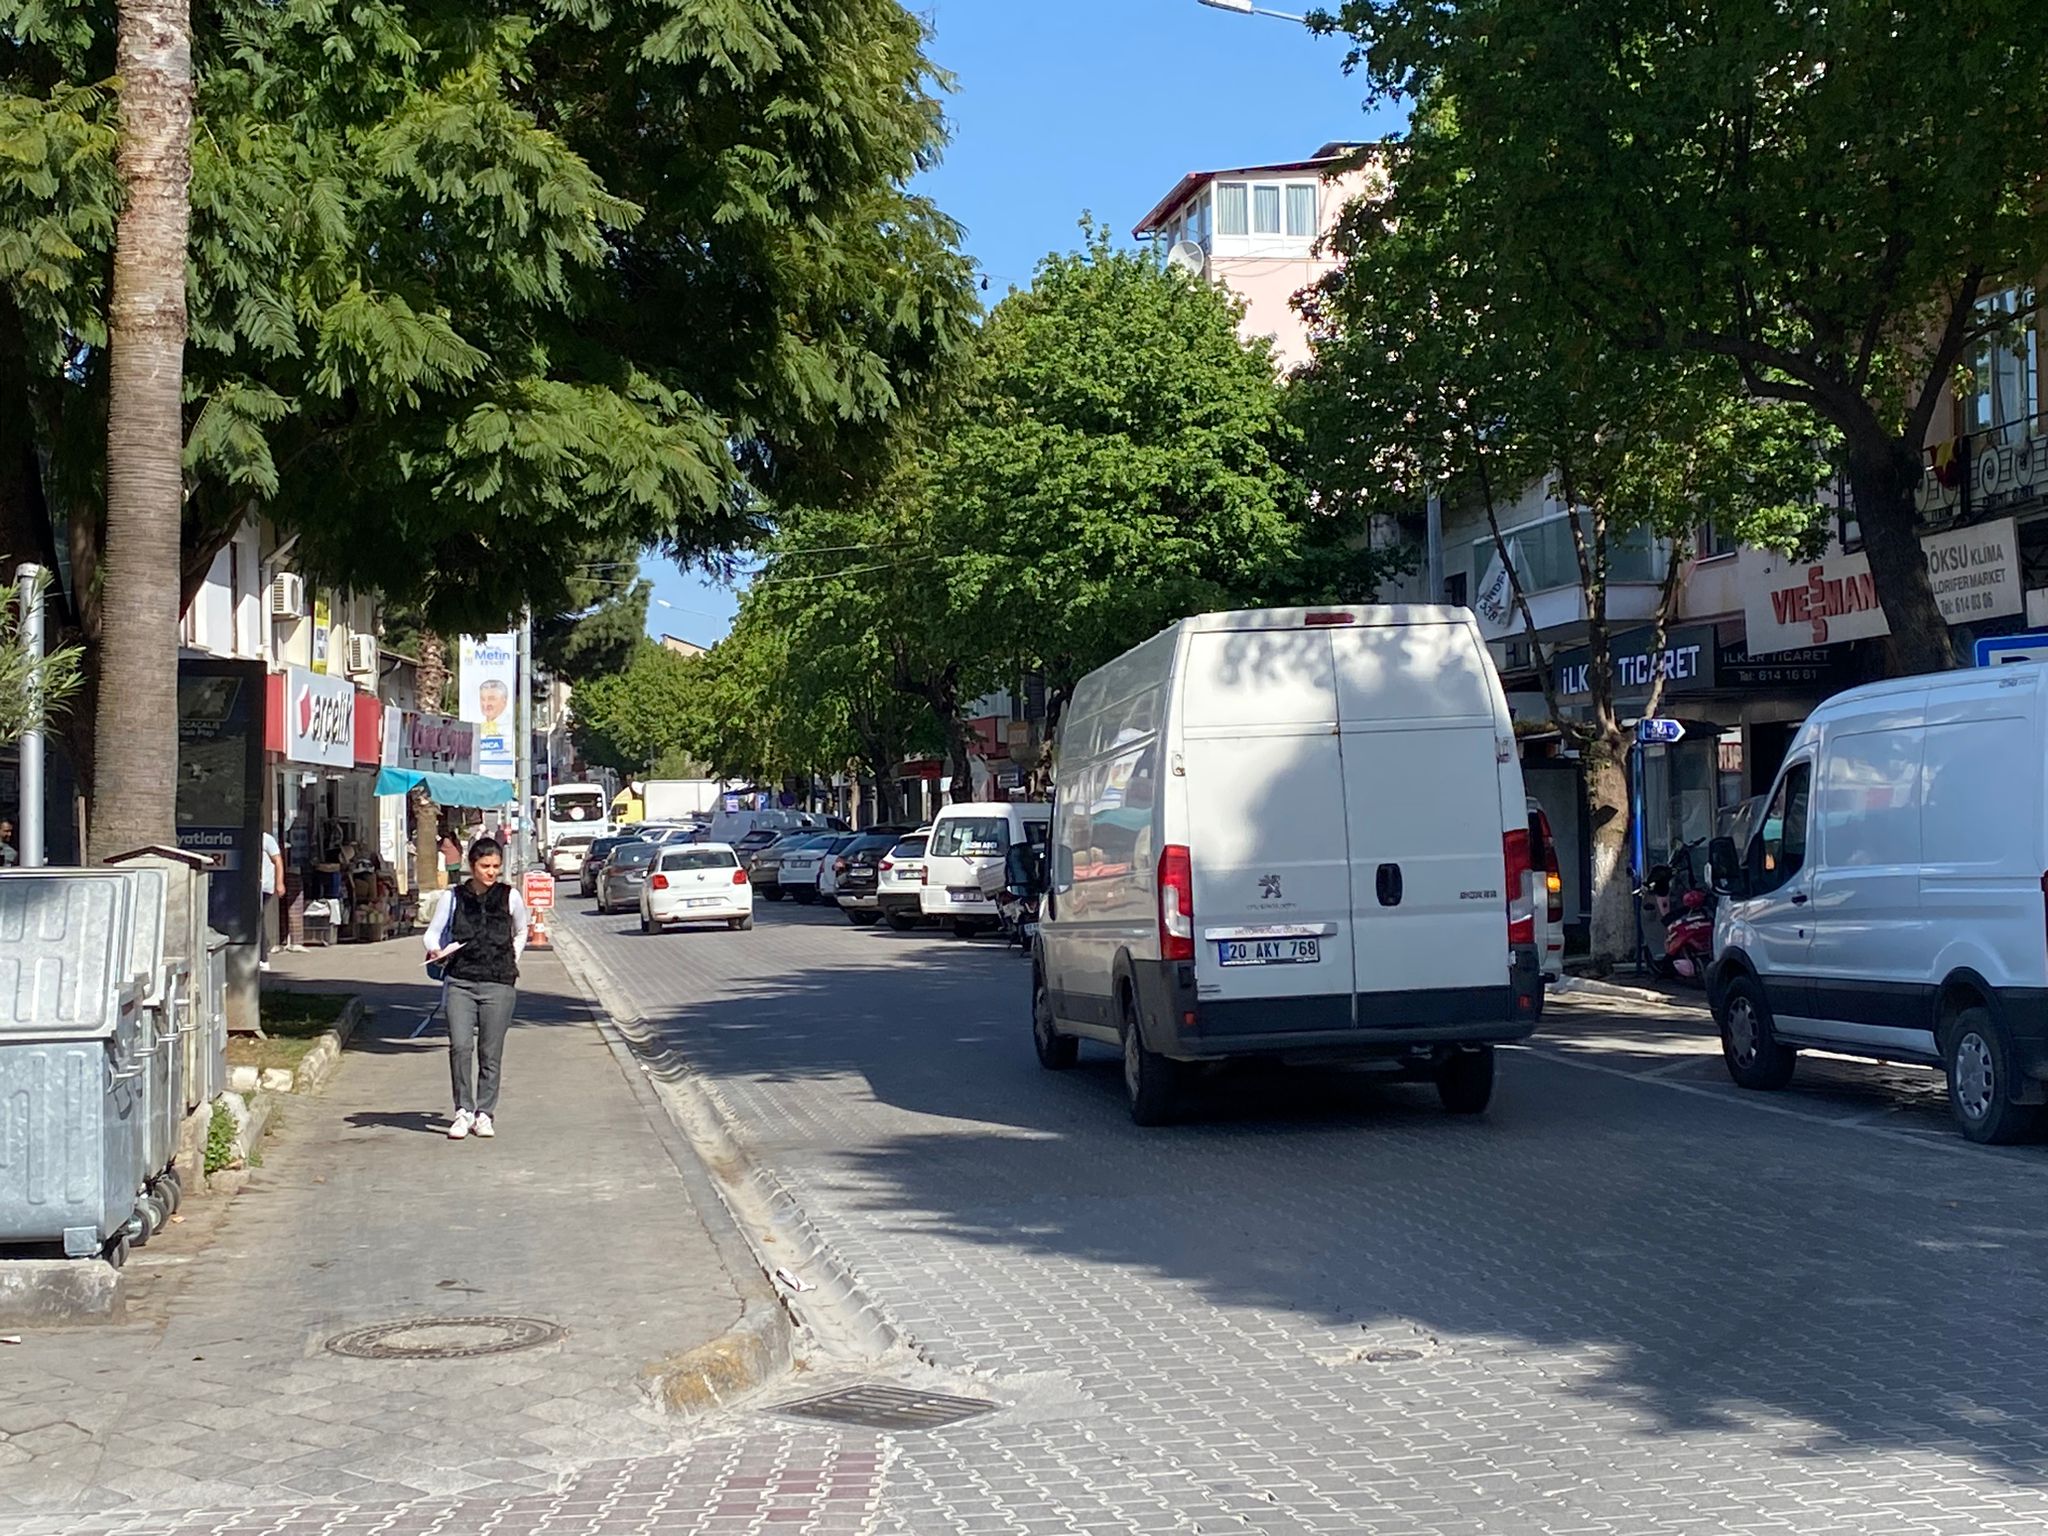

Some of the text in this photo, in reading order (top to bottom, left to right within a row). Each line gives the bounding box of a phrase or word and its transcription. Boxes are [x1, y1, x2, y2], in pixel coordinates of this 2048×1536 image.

[1928, 543, 1968, 575] ÖKSU
[1770, 565, 1880, 645] VIESSMAN
[475, 649, 510, 661] Metin
[310, 690, 353, 756] arçelik
[177, 832, 233, 845] yatlarla
[1230, 940, 1316, 959] 20 AKY 768
